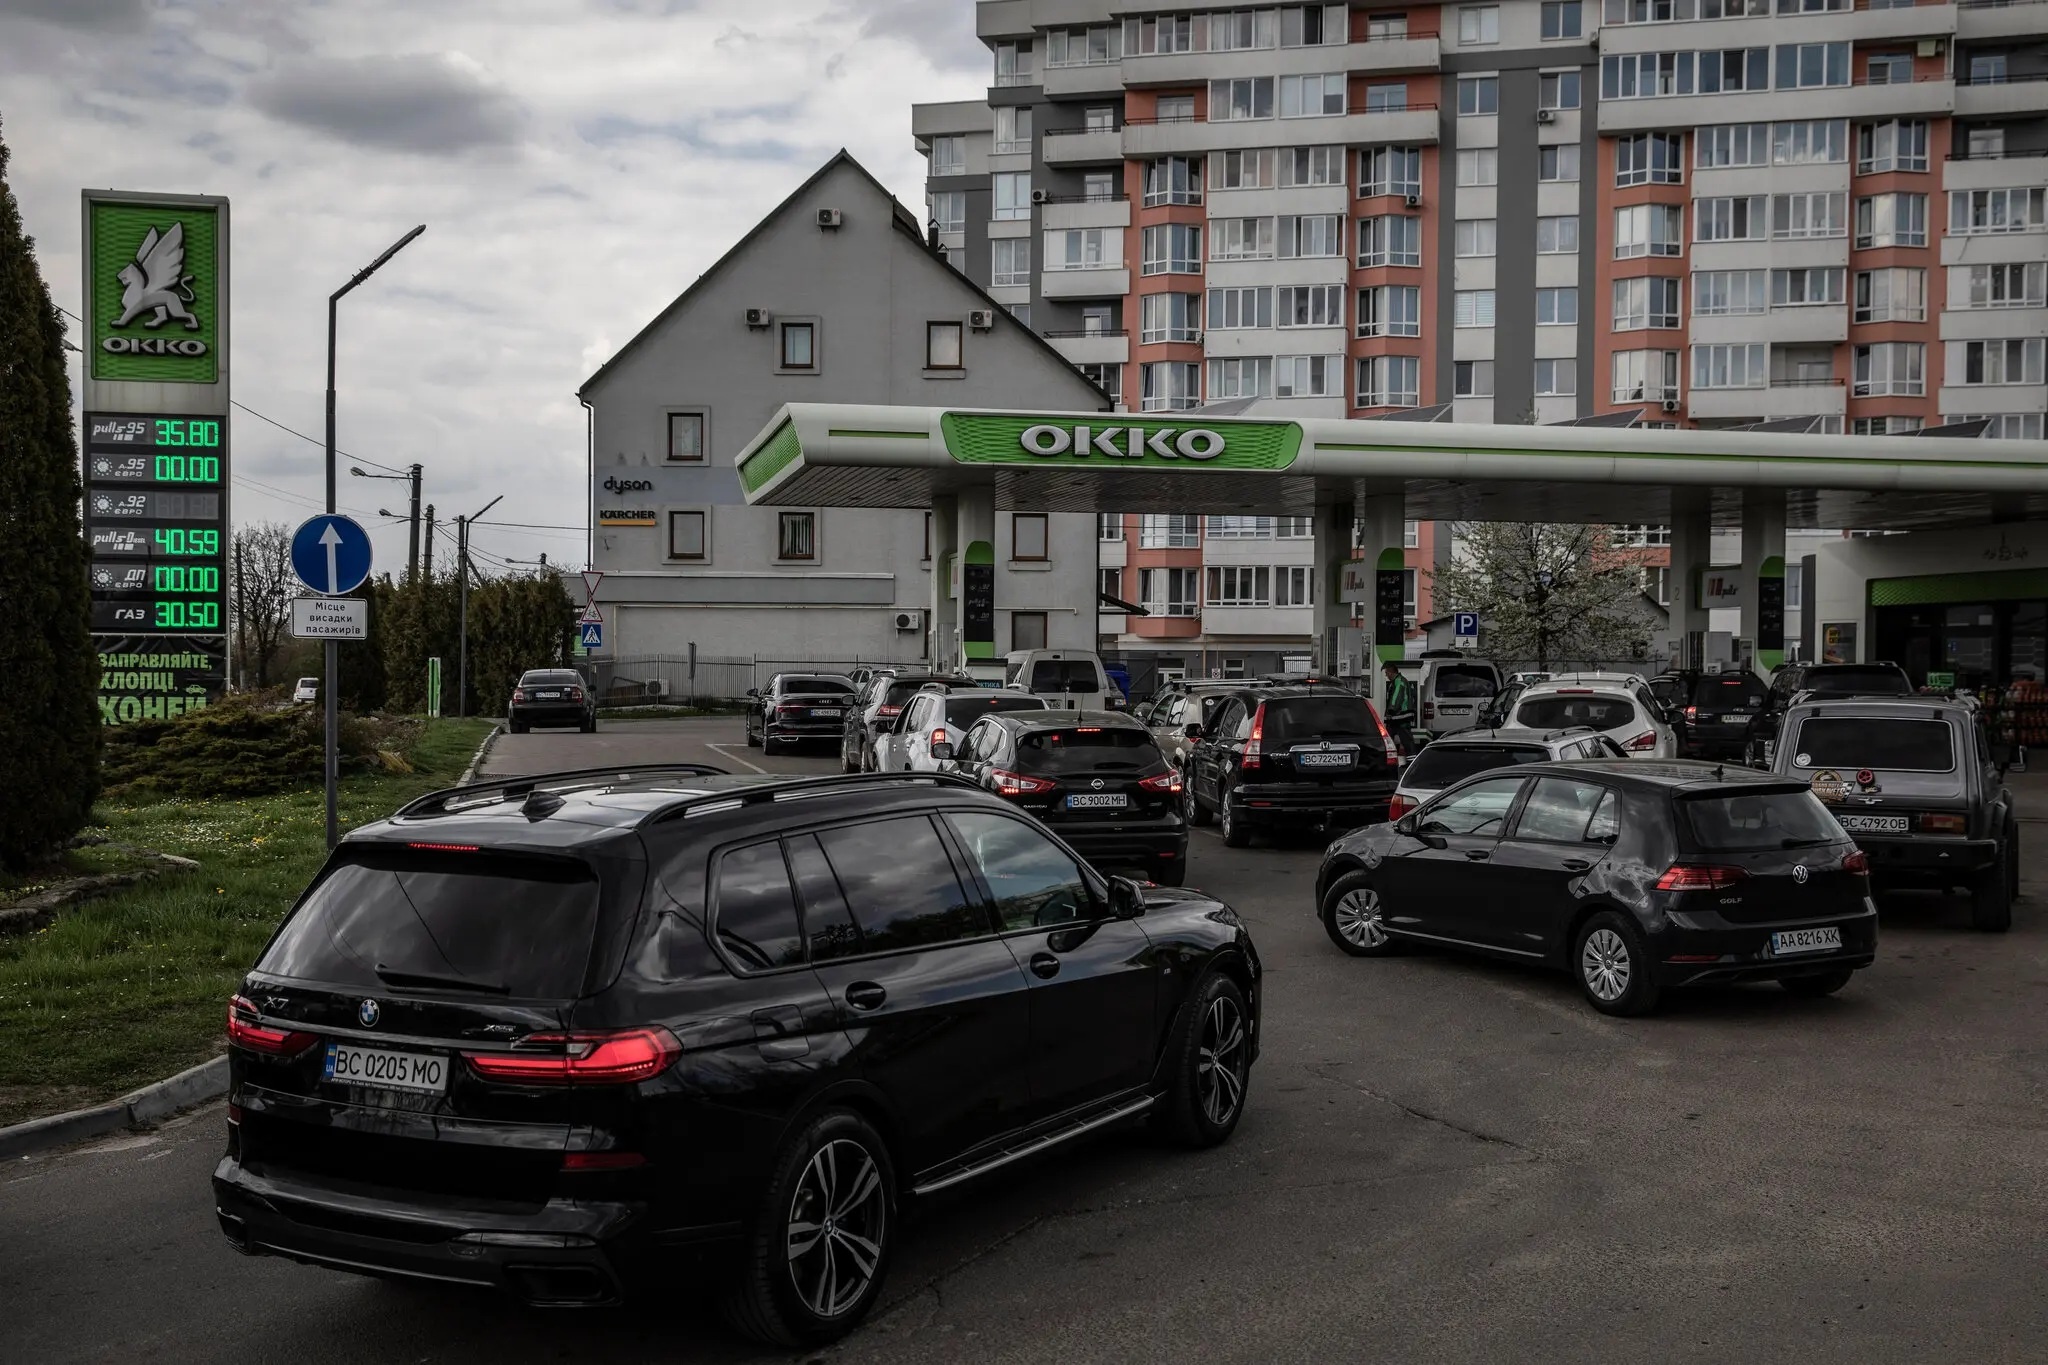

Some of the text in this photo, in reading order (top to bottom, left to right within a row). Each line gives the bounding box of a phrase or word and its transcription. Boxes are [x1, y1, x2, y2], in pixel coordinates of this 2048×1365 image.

[102, 336, 207, 357] OKKO
[155, 420, 219, 447] 35.80
[1020, 424, 1226, 460] OKKO
[155, 455, 219, 482] 00.00
[603, 476, 653, 495] dyson
[155, 529, 219, 555] 40.59
[124, 569, 146, 581] ДП
[155, 567, 219, 592] 00.00
[1674, 587, 1680, 601] 2
[114, 609, 146, 620] ГАЗ
[155, 602, 219, 627] 30.50
[315, 602, 346, 612] Місце
[309, 615, 353, 623] висадки
[1460, 615, 1474, 633] P
[306, 625, 361, 636] пасажирів
[97, 651, 212, 670] ЗАПРАВЛЯЙТЕ,
[1305, 755, 1350, 763] BC 7224 MT
[1072, 795, 1127, 806] BC 9002 MH
[1840, 817, 1907, 829] BC 4792 OB
[1719, 897, 1743, 905] GOLF
[1781, 929, 1840, 948] AA 8216 XK
[263, 995, 289, 1010] X7
[325, 1064, 334, 1073] UA
[335, 1050, 441, 1085] BC 0205 MO
